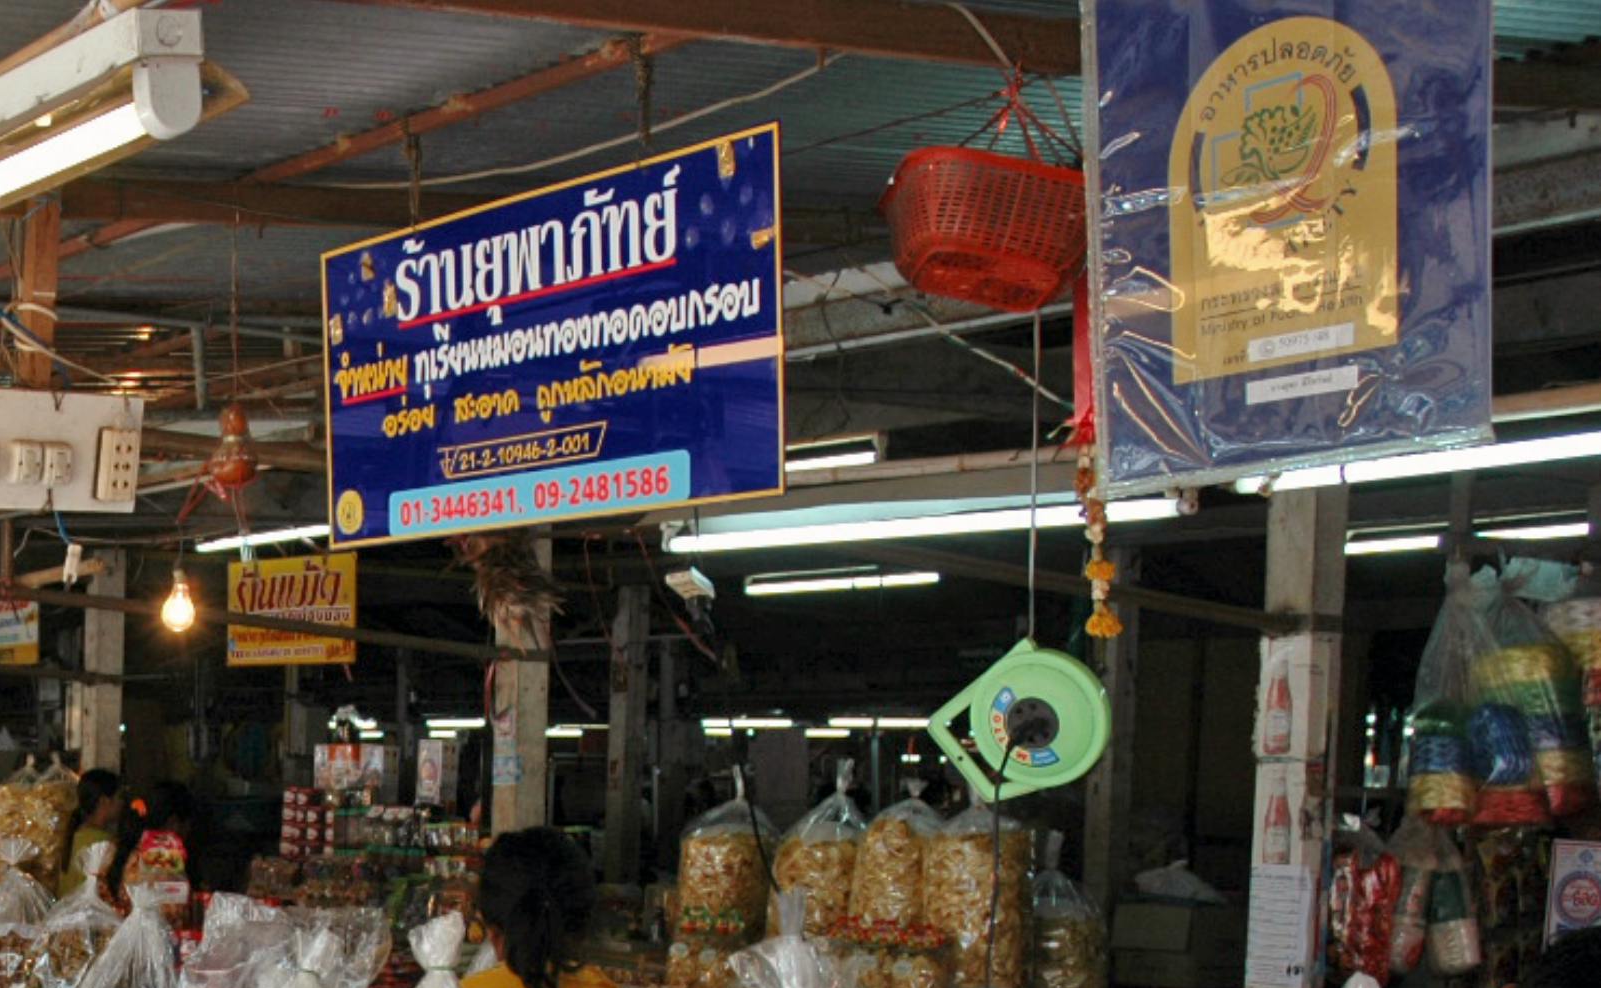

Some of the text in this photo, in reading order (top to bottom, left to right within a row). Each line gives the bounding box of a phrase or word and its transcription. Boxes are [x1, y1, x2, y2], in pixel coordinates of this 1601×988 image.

[1200, 36, 1357, 122] อาหารปลอดภัย
[395, 164, 681, 326] ร้านยุพาภัทย์
[333, 277, 761, 401] จำหน่าย ทุเรียนหมอนทองทอดอบกรอบ
[380, 343, 693, 438] อร่อย สะอาด ถูกหลักอนามัย
[533, 466, 670, 509] 09-2481586
